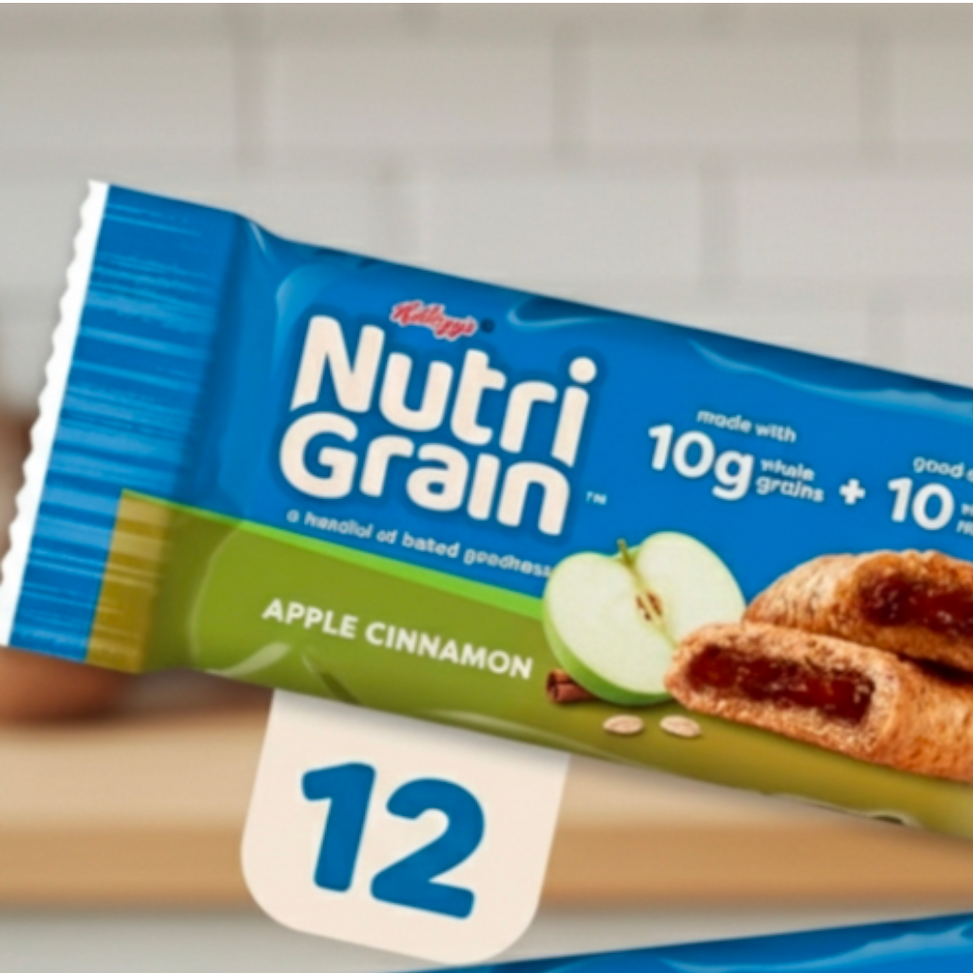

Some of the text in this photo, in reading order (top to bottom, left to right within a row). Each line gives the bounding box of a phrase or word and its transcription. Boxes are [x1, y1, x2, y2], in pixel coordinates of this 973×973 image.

[290, 315, 597, 468] Nutri
[279, 411, 570, 536] Grain
[648, 423, 754, 500] 10g
[887, 477, 954, 530] 10
[262, 598, 533, 680] APPLE CINNAMON
[301, 762, 486, 920] 12
